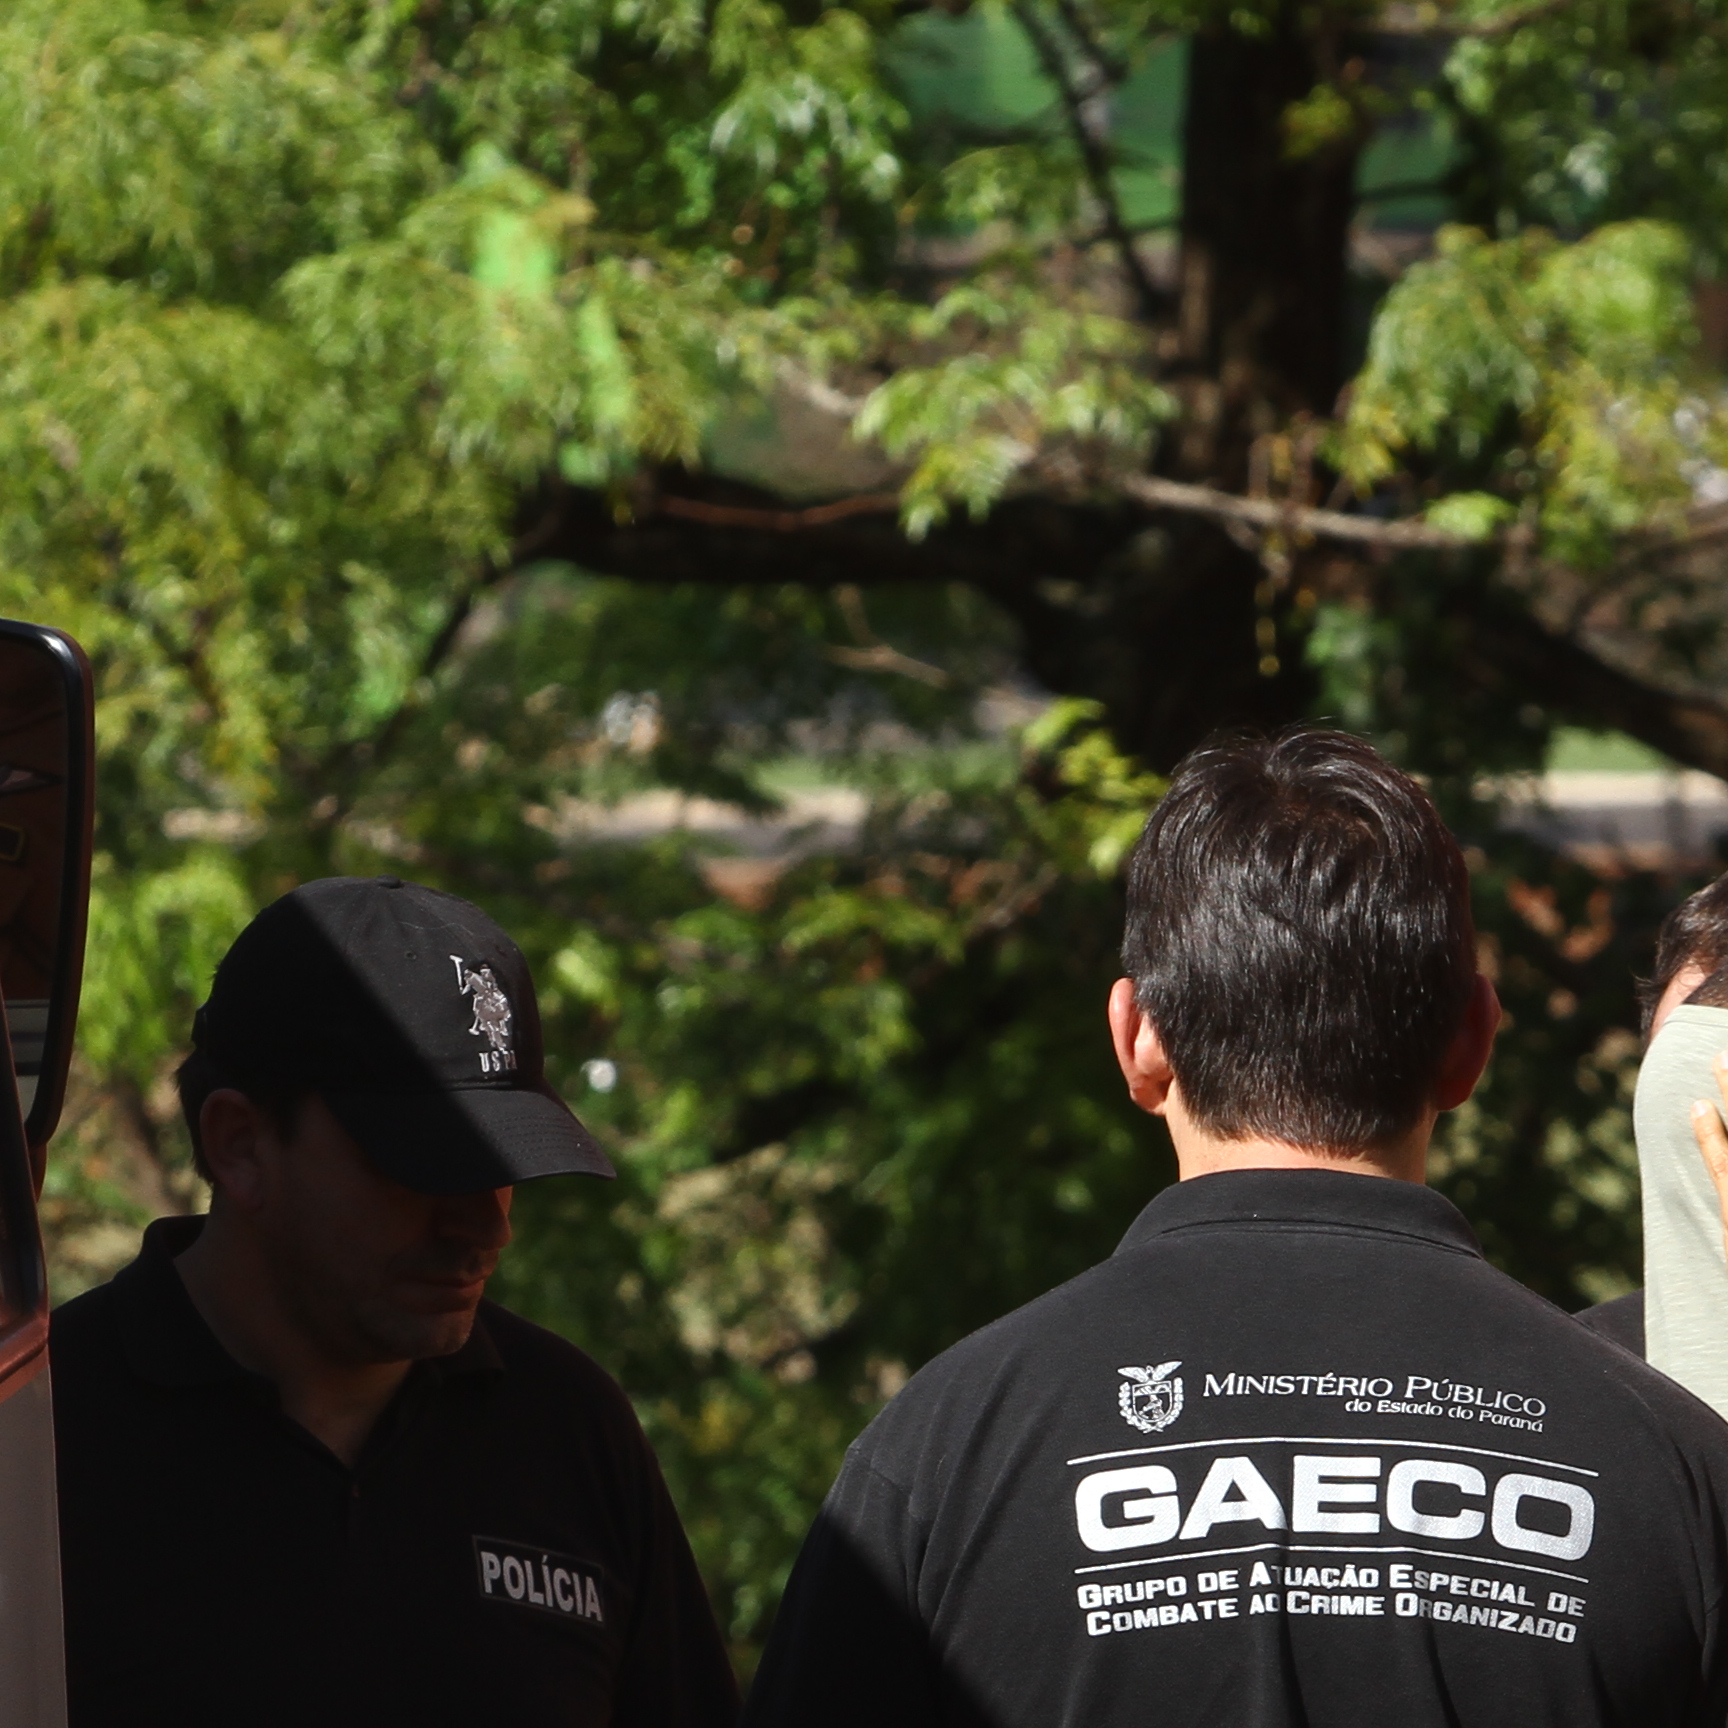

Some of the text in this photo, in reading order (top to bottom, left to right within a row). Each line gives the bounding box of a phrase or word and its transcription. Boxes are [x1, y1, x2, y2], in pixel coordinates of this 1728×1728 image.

[1203, 1372, 1546, 1417] MINISTÉRIO PÚBLICO
[1345, 1399, 1543, 1433] do Estado do Paraná
[1074, 1455, 1595, 1560] GAECO
[481, 1551, 603, 1622] POLÍCIA
[1077, 1561, 1587, 1618] GRUPO DE ATUAÇÃO ESPECIAL DE
[1086, 1590, 1577, 1643] COMBATE AO CRIME ORGANIZADO
